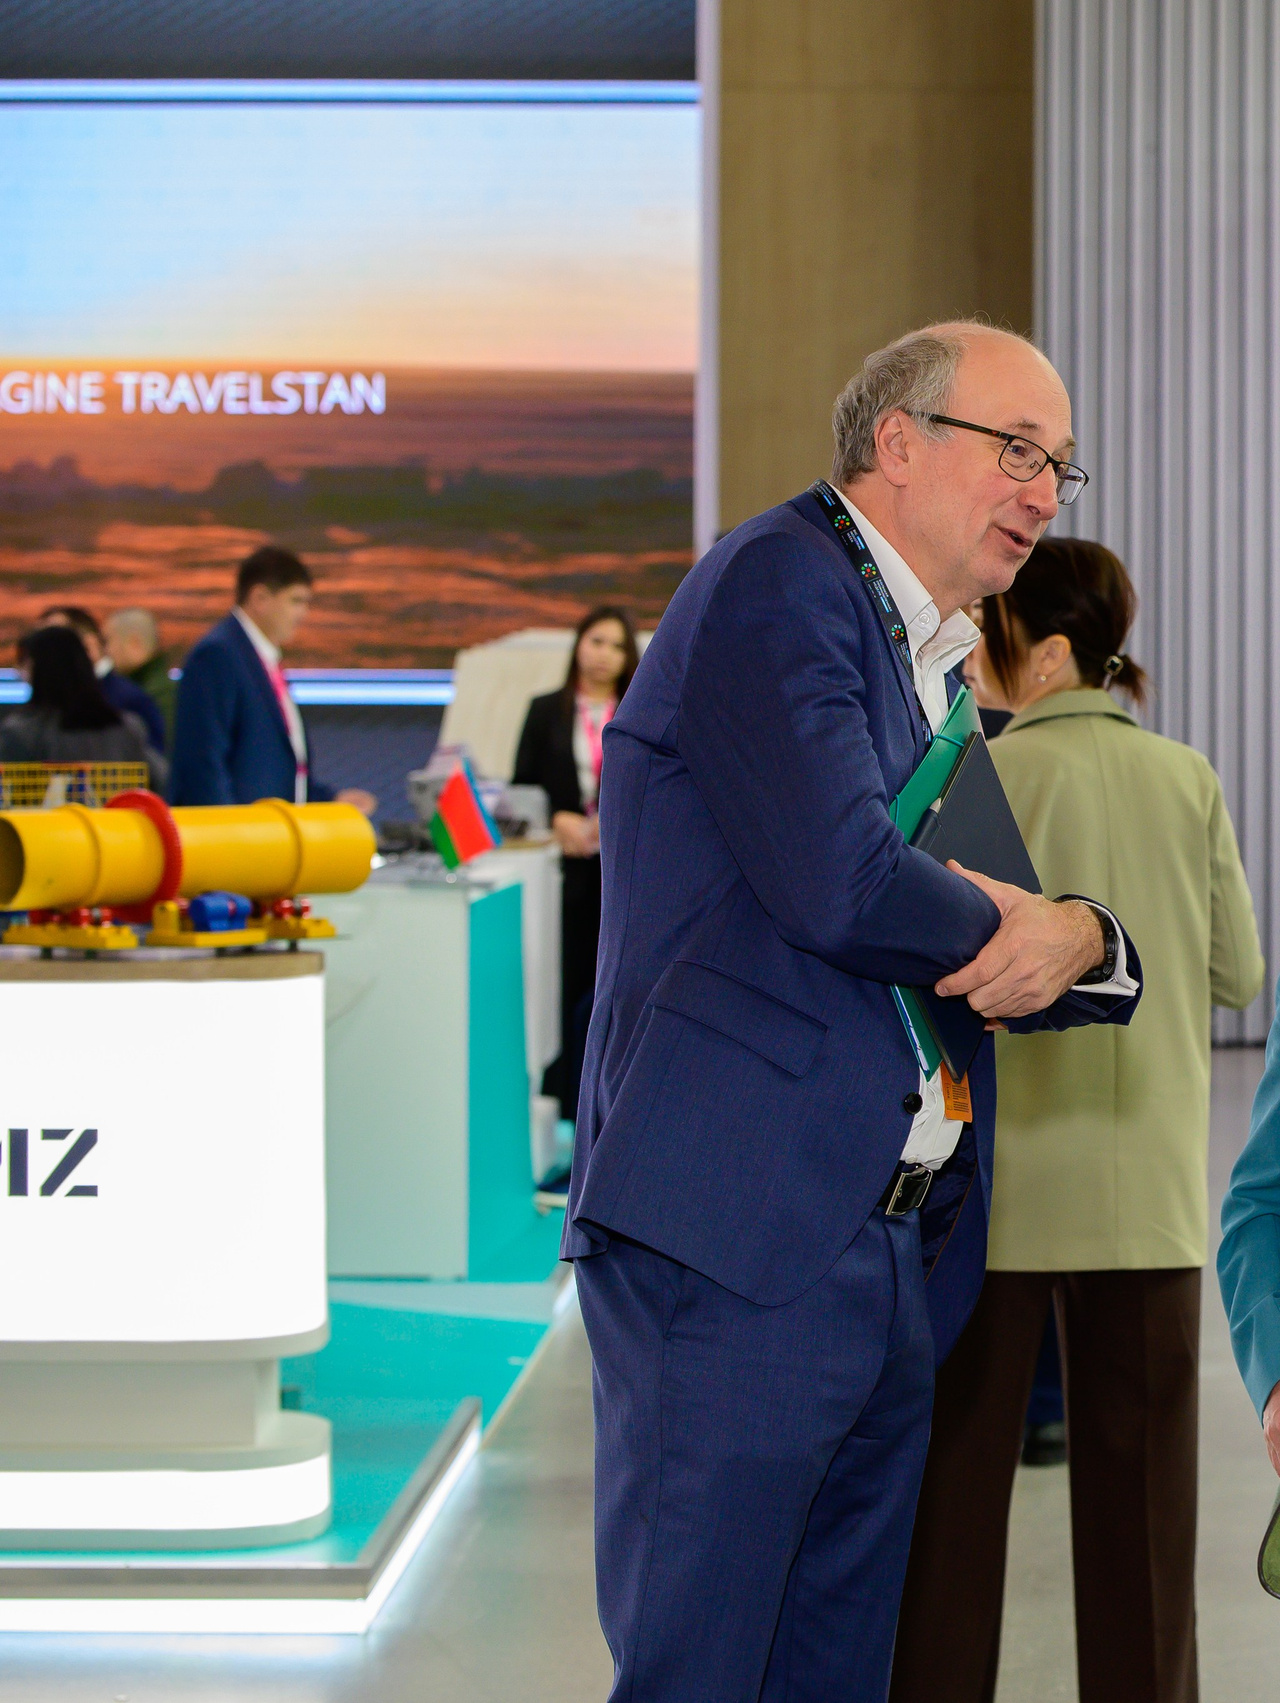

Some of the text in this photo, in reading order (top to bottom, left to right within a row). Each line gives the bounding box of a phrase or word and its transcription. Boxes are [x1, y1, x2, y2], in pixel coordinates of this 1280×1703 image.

[0, 370, 386, 416] GINE TRAVELSTAN
[0, 1127, 99, 1197] IZ
